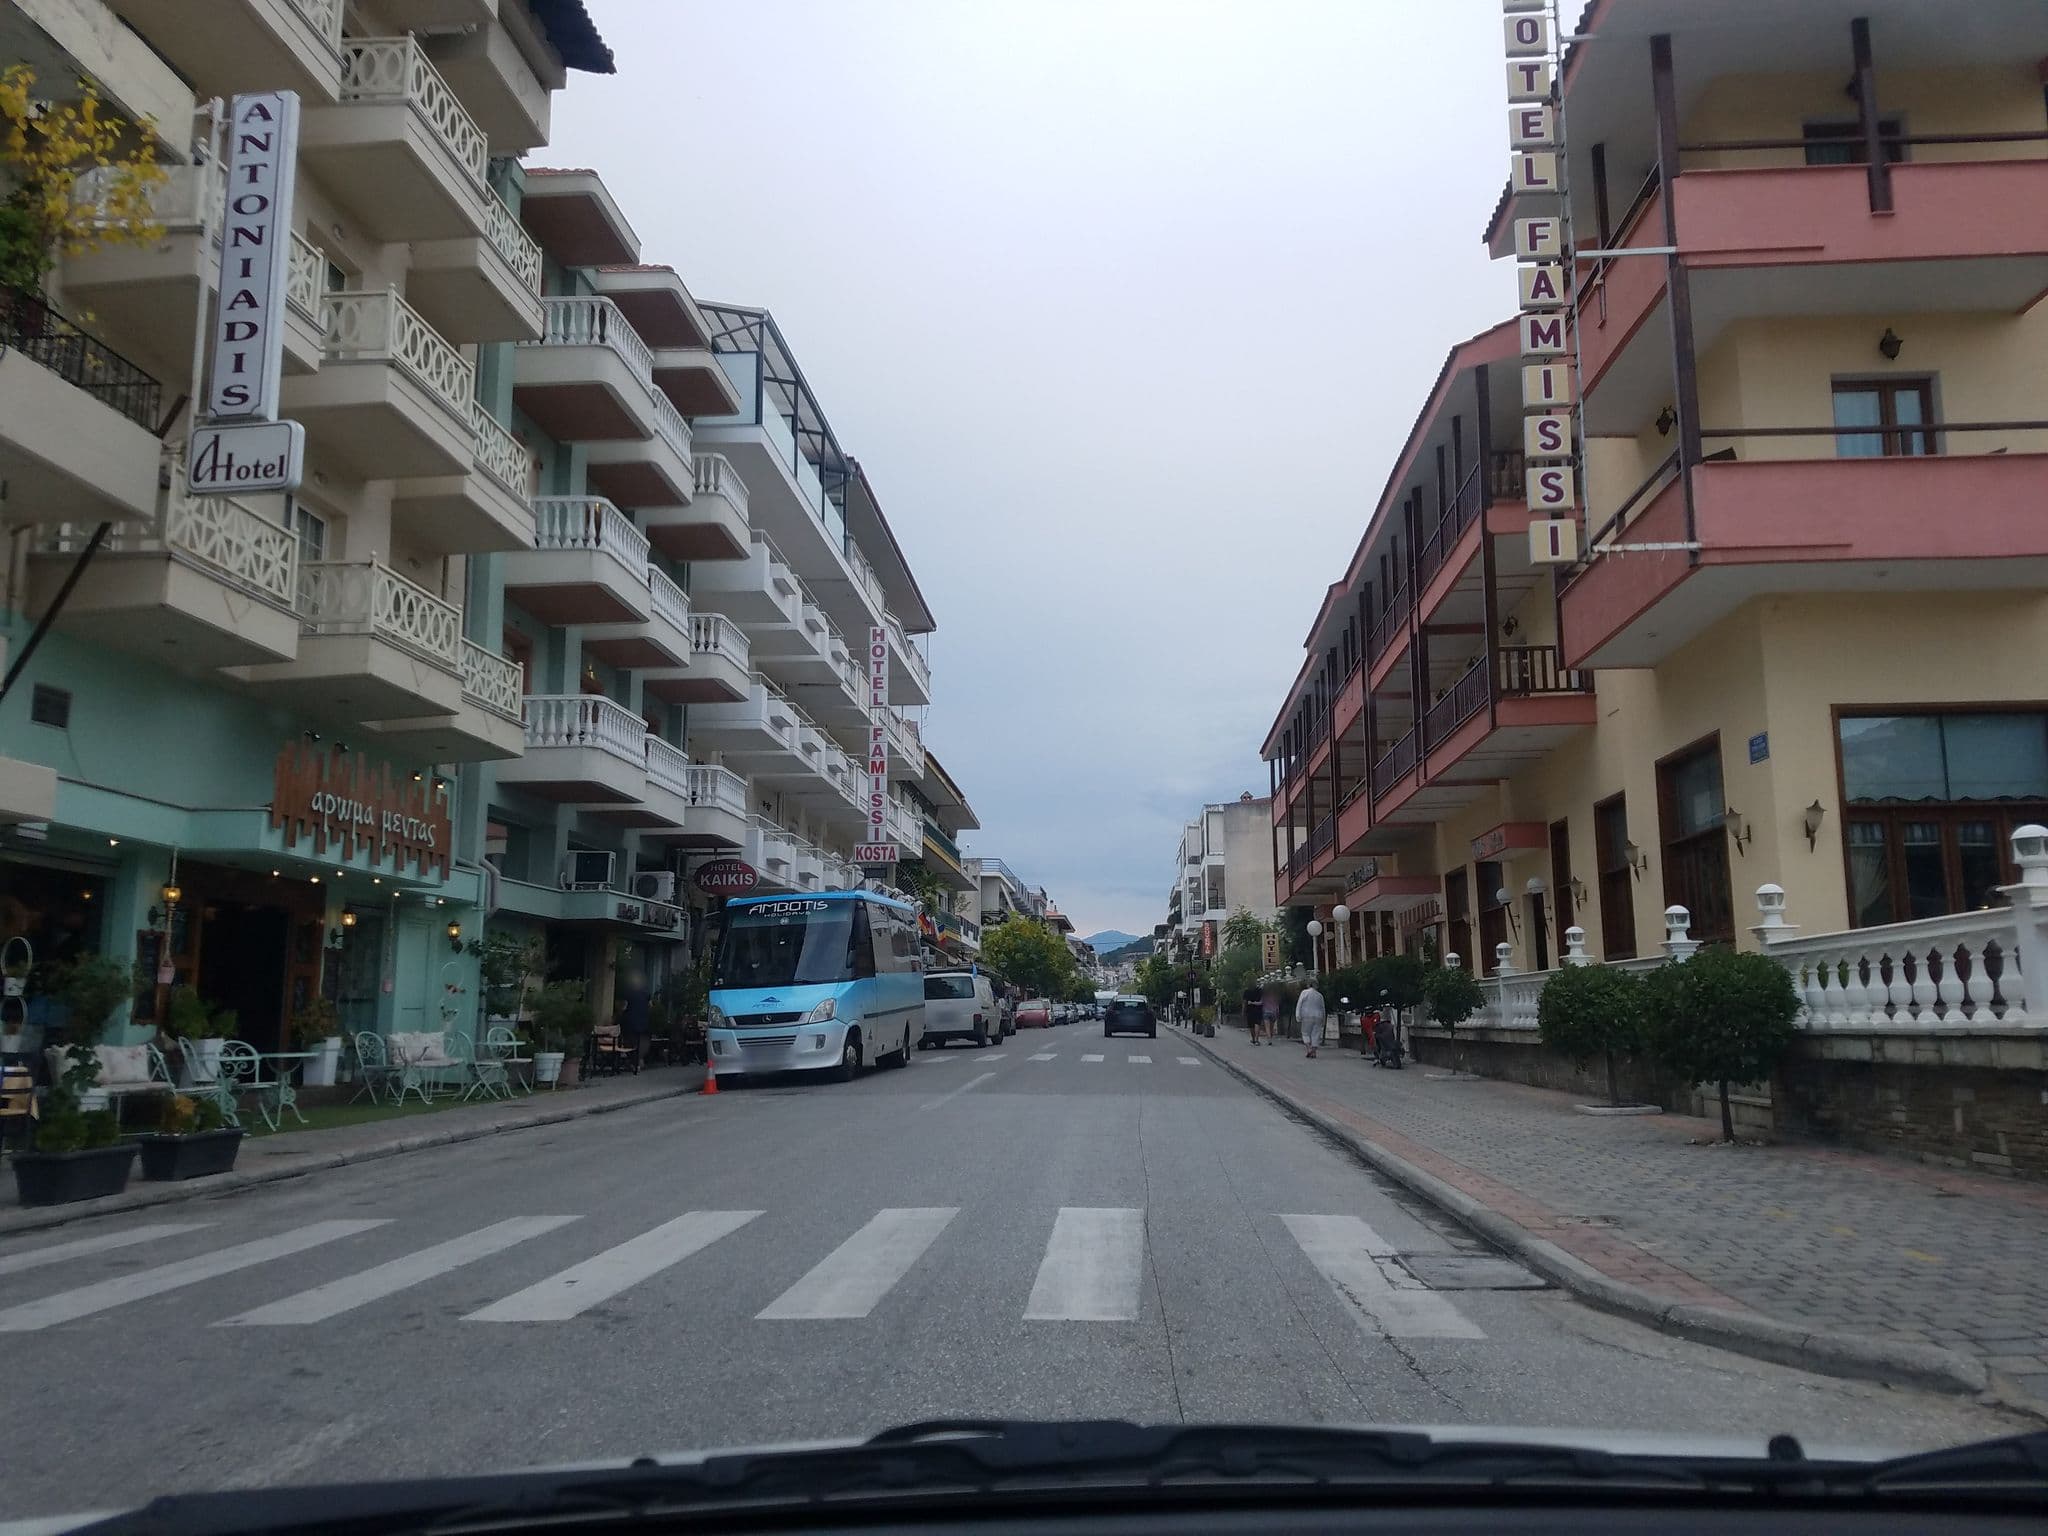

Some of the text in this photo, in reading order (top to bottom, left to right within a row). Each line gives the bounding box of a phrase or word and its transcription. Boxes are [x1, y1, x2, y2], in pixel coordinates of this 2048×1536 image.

[220, 102, 275, 408] ANTONIADIS
[1514, 0, 1564, 557] OTEL FAMISSI
[869, 628, 886, 842] HOTEL FAMISSI
[855, 845, 897, 861] KOSTA
[710, 863, 742, 872] HOTEL
[700, 873, 754, 886] KAIKIS
[748, 900, 829, 915] AMBOTIS
